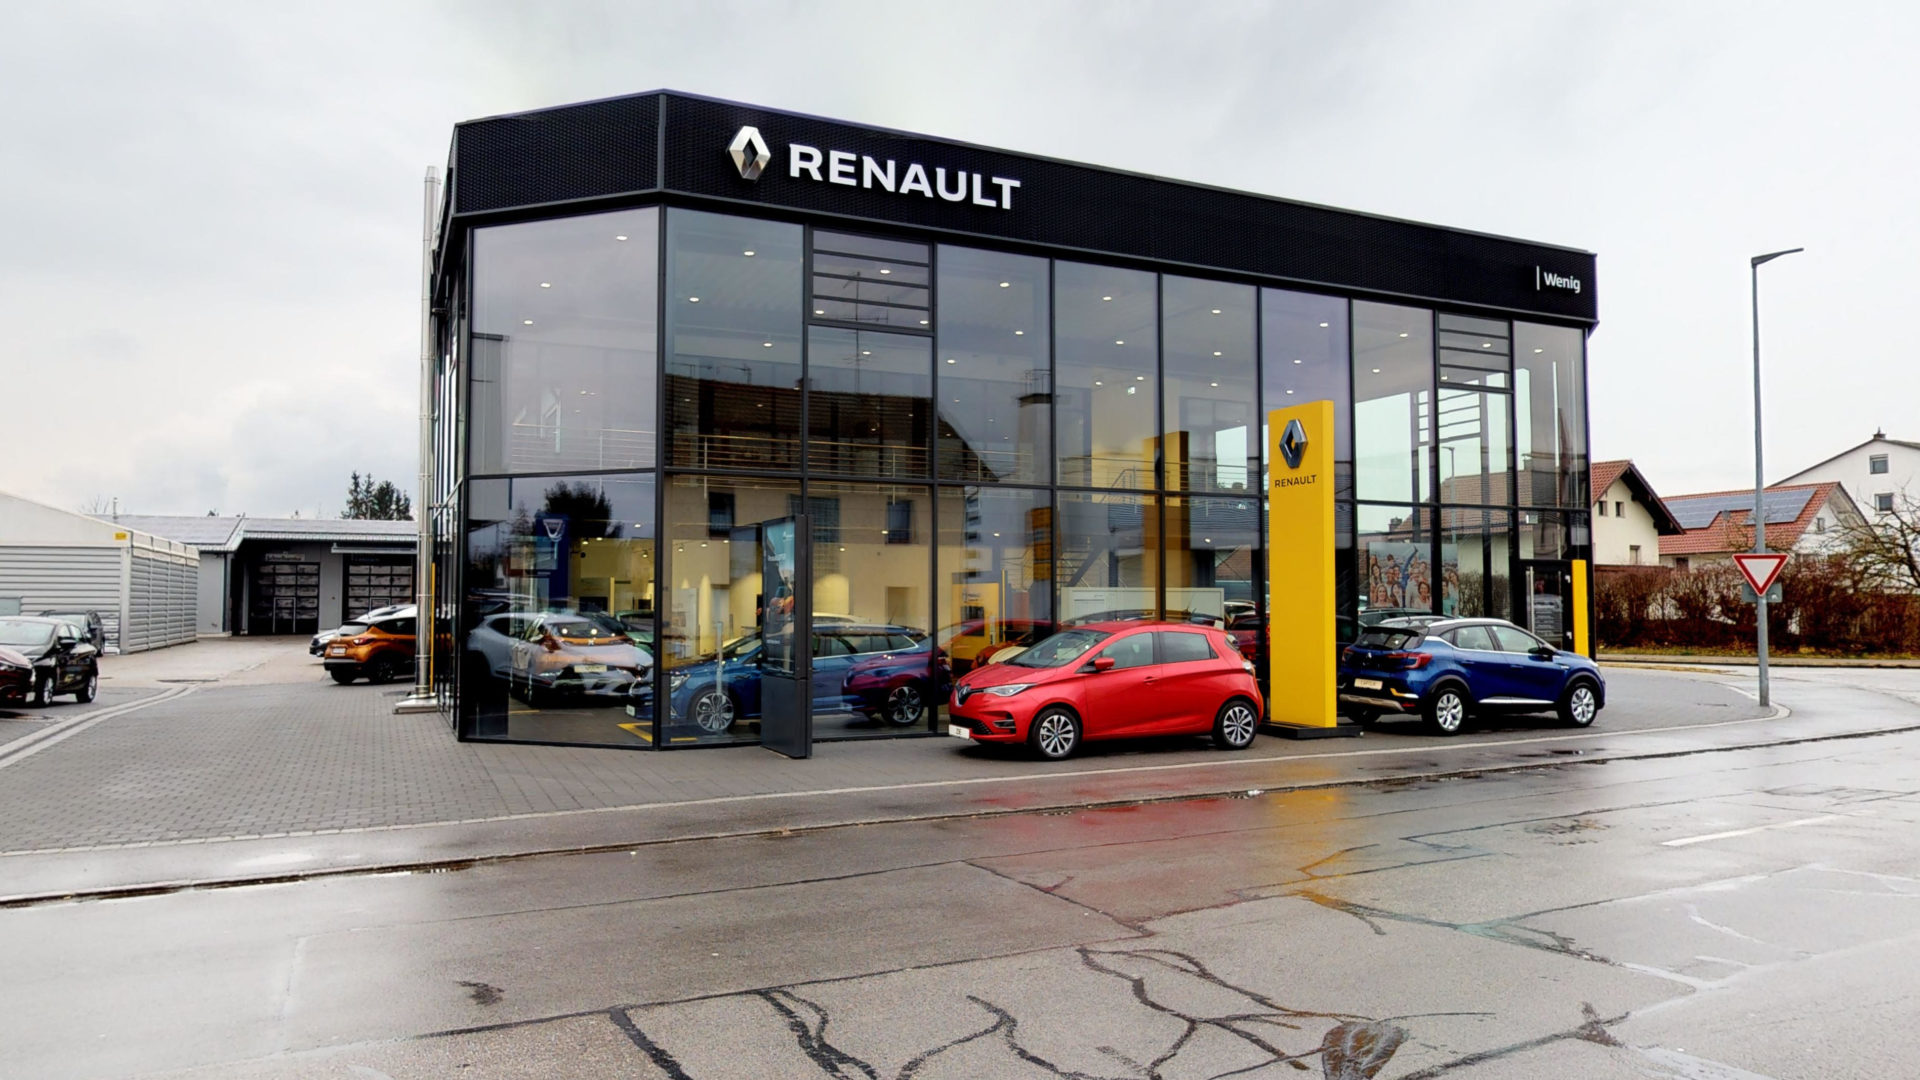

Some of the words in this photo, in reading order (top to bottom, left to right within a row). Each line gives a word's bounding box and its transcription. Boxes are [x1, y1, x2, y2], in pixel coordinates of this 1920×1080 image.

[789, 143, 1021, 210] RENAULT
[1543, 271, 1581, 294] Wenig
[1274, 474, 1317, 488] RENAULT
